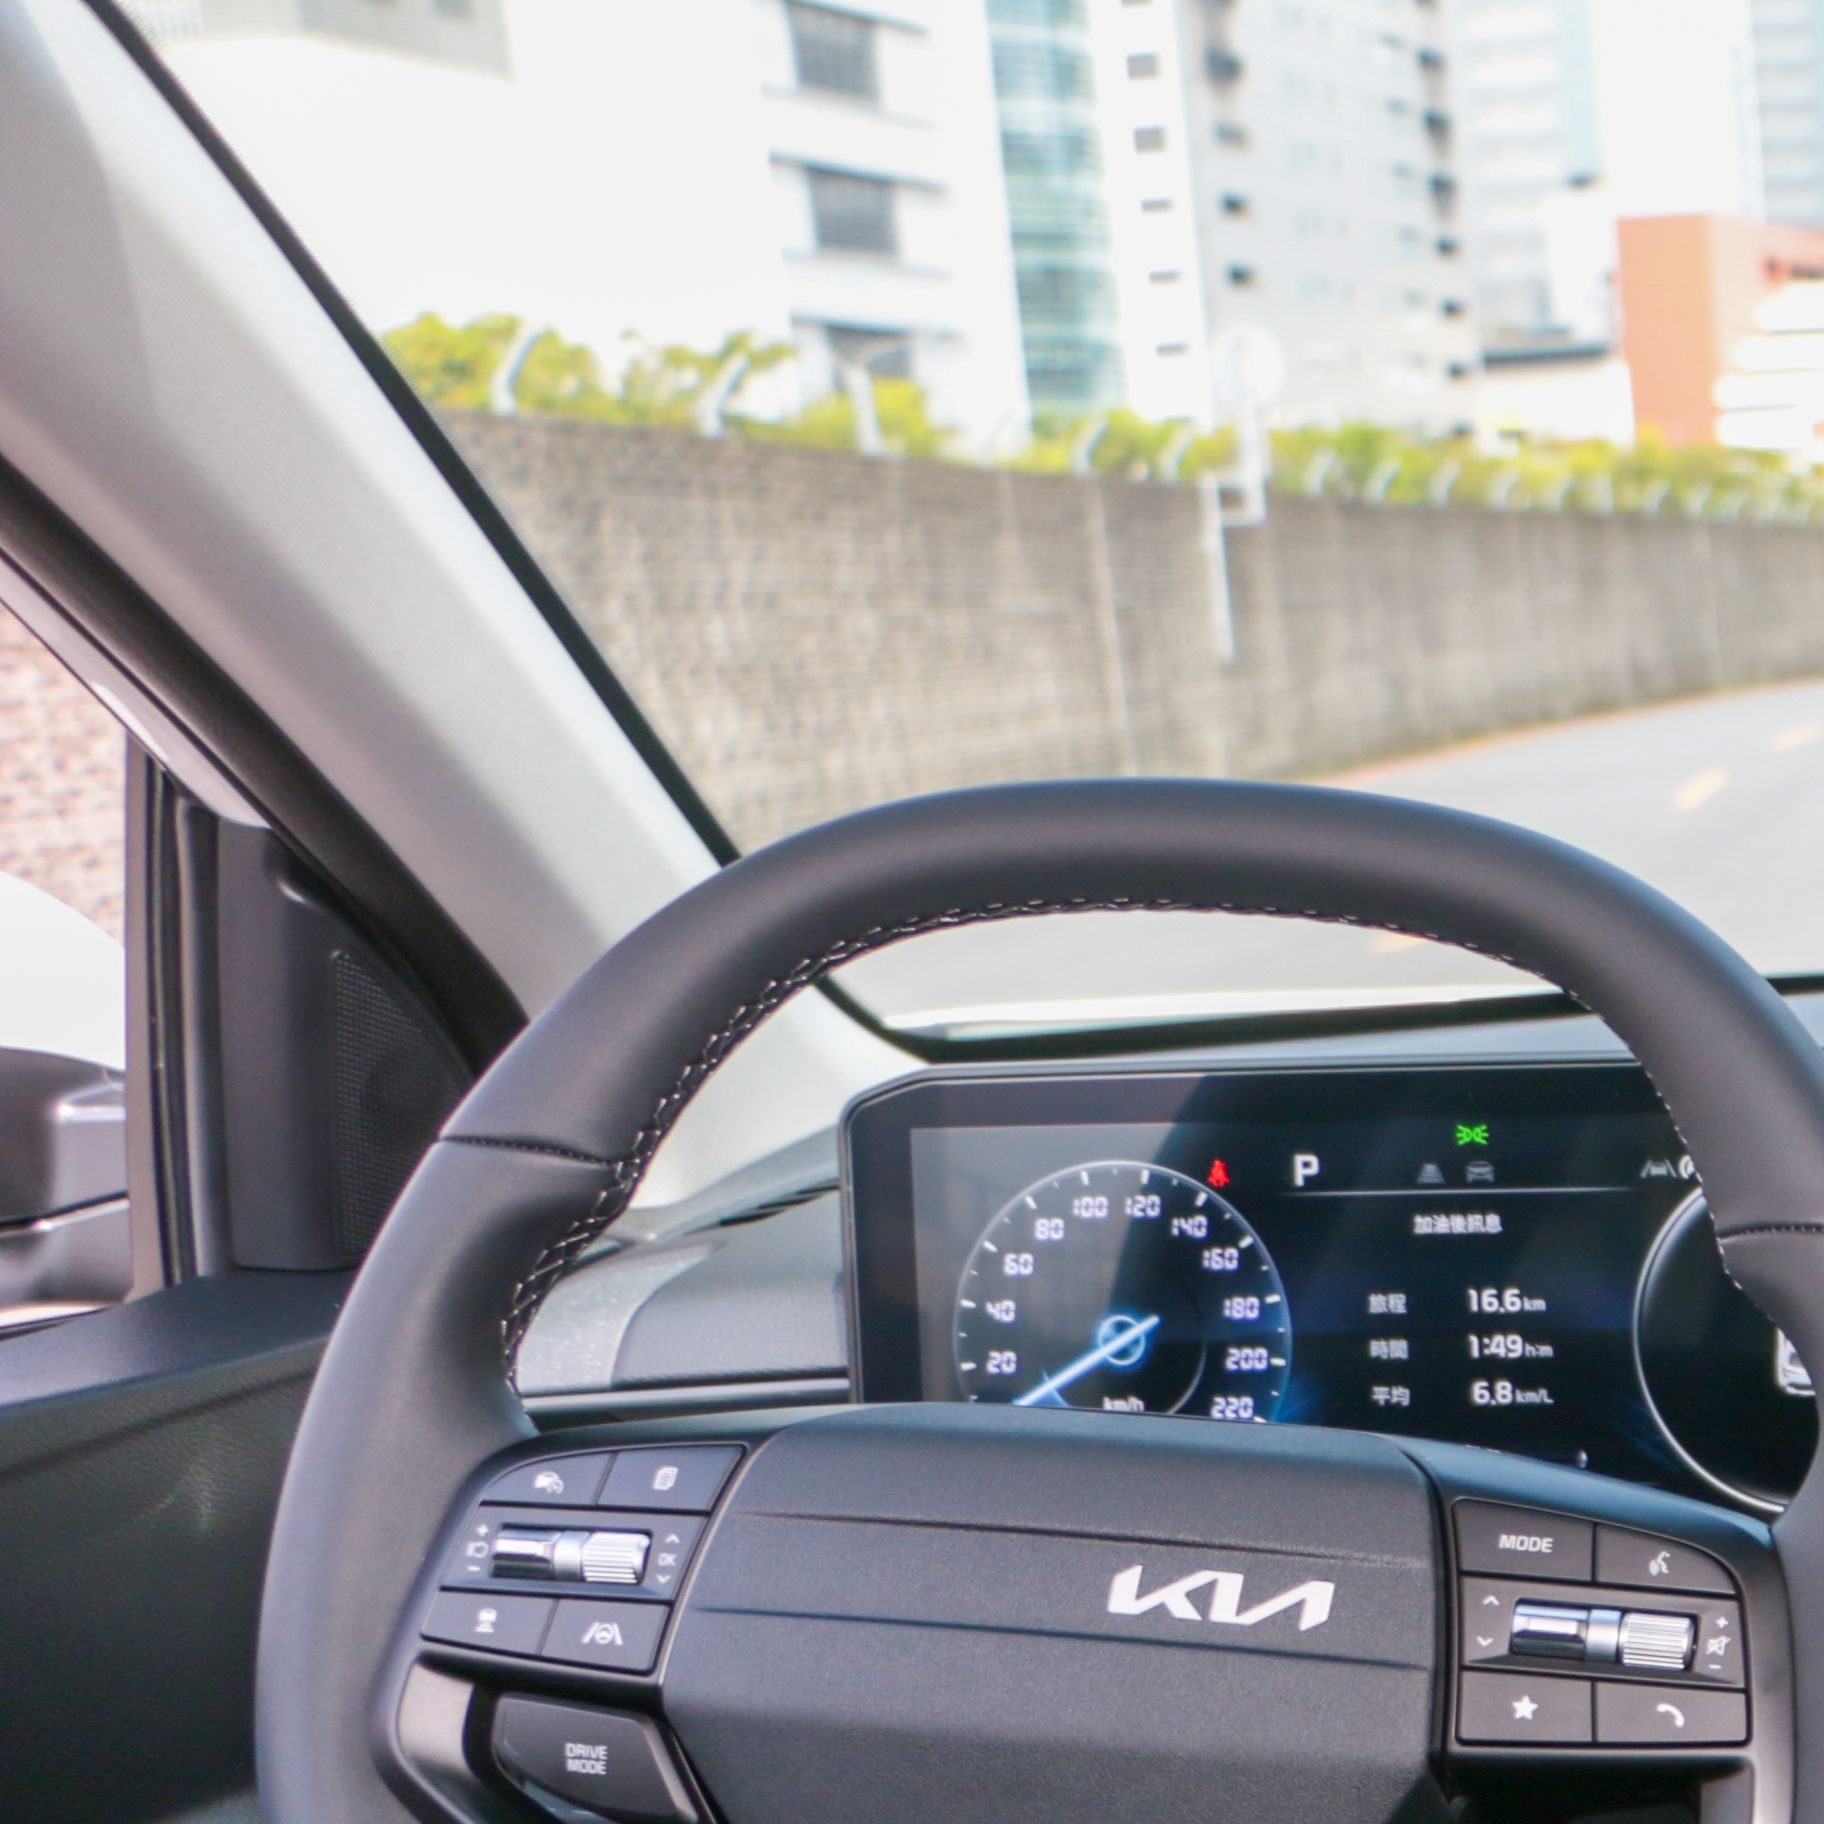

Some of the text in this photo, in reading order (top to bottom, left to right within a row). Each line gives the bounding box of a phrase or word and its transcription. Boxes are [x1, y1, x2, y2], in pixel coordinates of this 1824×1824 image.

[1294, 1155, 1319, 1186] P
[1074, 1197, 1108, 1218] 100
[1125, 1195, 1160, 1218] 120
[1035, 1219, 1064, 1240] 80
[1172, 1216, 1208, 1239] 140
[1414, 1214, 1502, 1234] 加油後訊息
[1004, 1253, 1034, 1276] 60
[1203, 1248, 1238, 1271] 160
[986, 1300, 1016, 1323] 40
[1224, 1297, 1260, 1321] 180
[1369, 1294, 1407, 1313] 旅程
[1468, 1289, 1521, 1314] 16.6
[1370, 1340, 1408, 1359] 時間
[1470, 1335, 1523, 1358] 1:49
[987, 1351, 1017, 1374] 20
[1226, 1348, 1268, 1371] 200
[1102, 1396, 1144, 1411] km/h
[1373, 1386, 1410, 1406] 平均
[1472, 1381, 1513, 1405] 6.8
[1211, 1396, 1253, 1418] 220
[1499, 1534, 1553, 1553] MODE
[658, 1553, 676, 1565] OK
[1107, 1565, 1334, 1631] KIA
[566, 1743, 607, 1759] DRIVE
[566, 1759, 606, 1774] MODE
